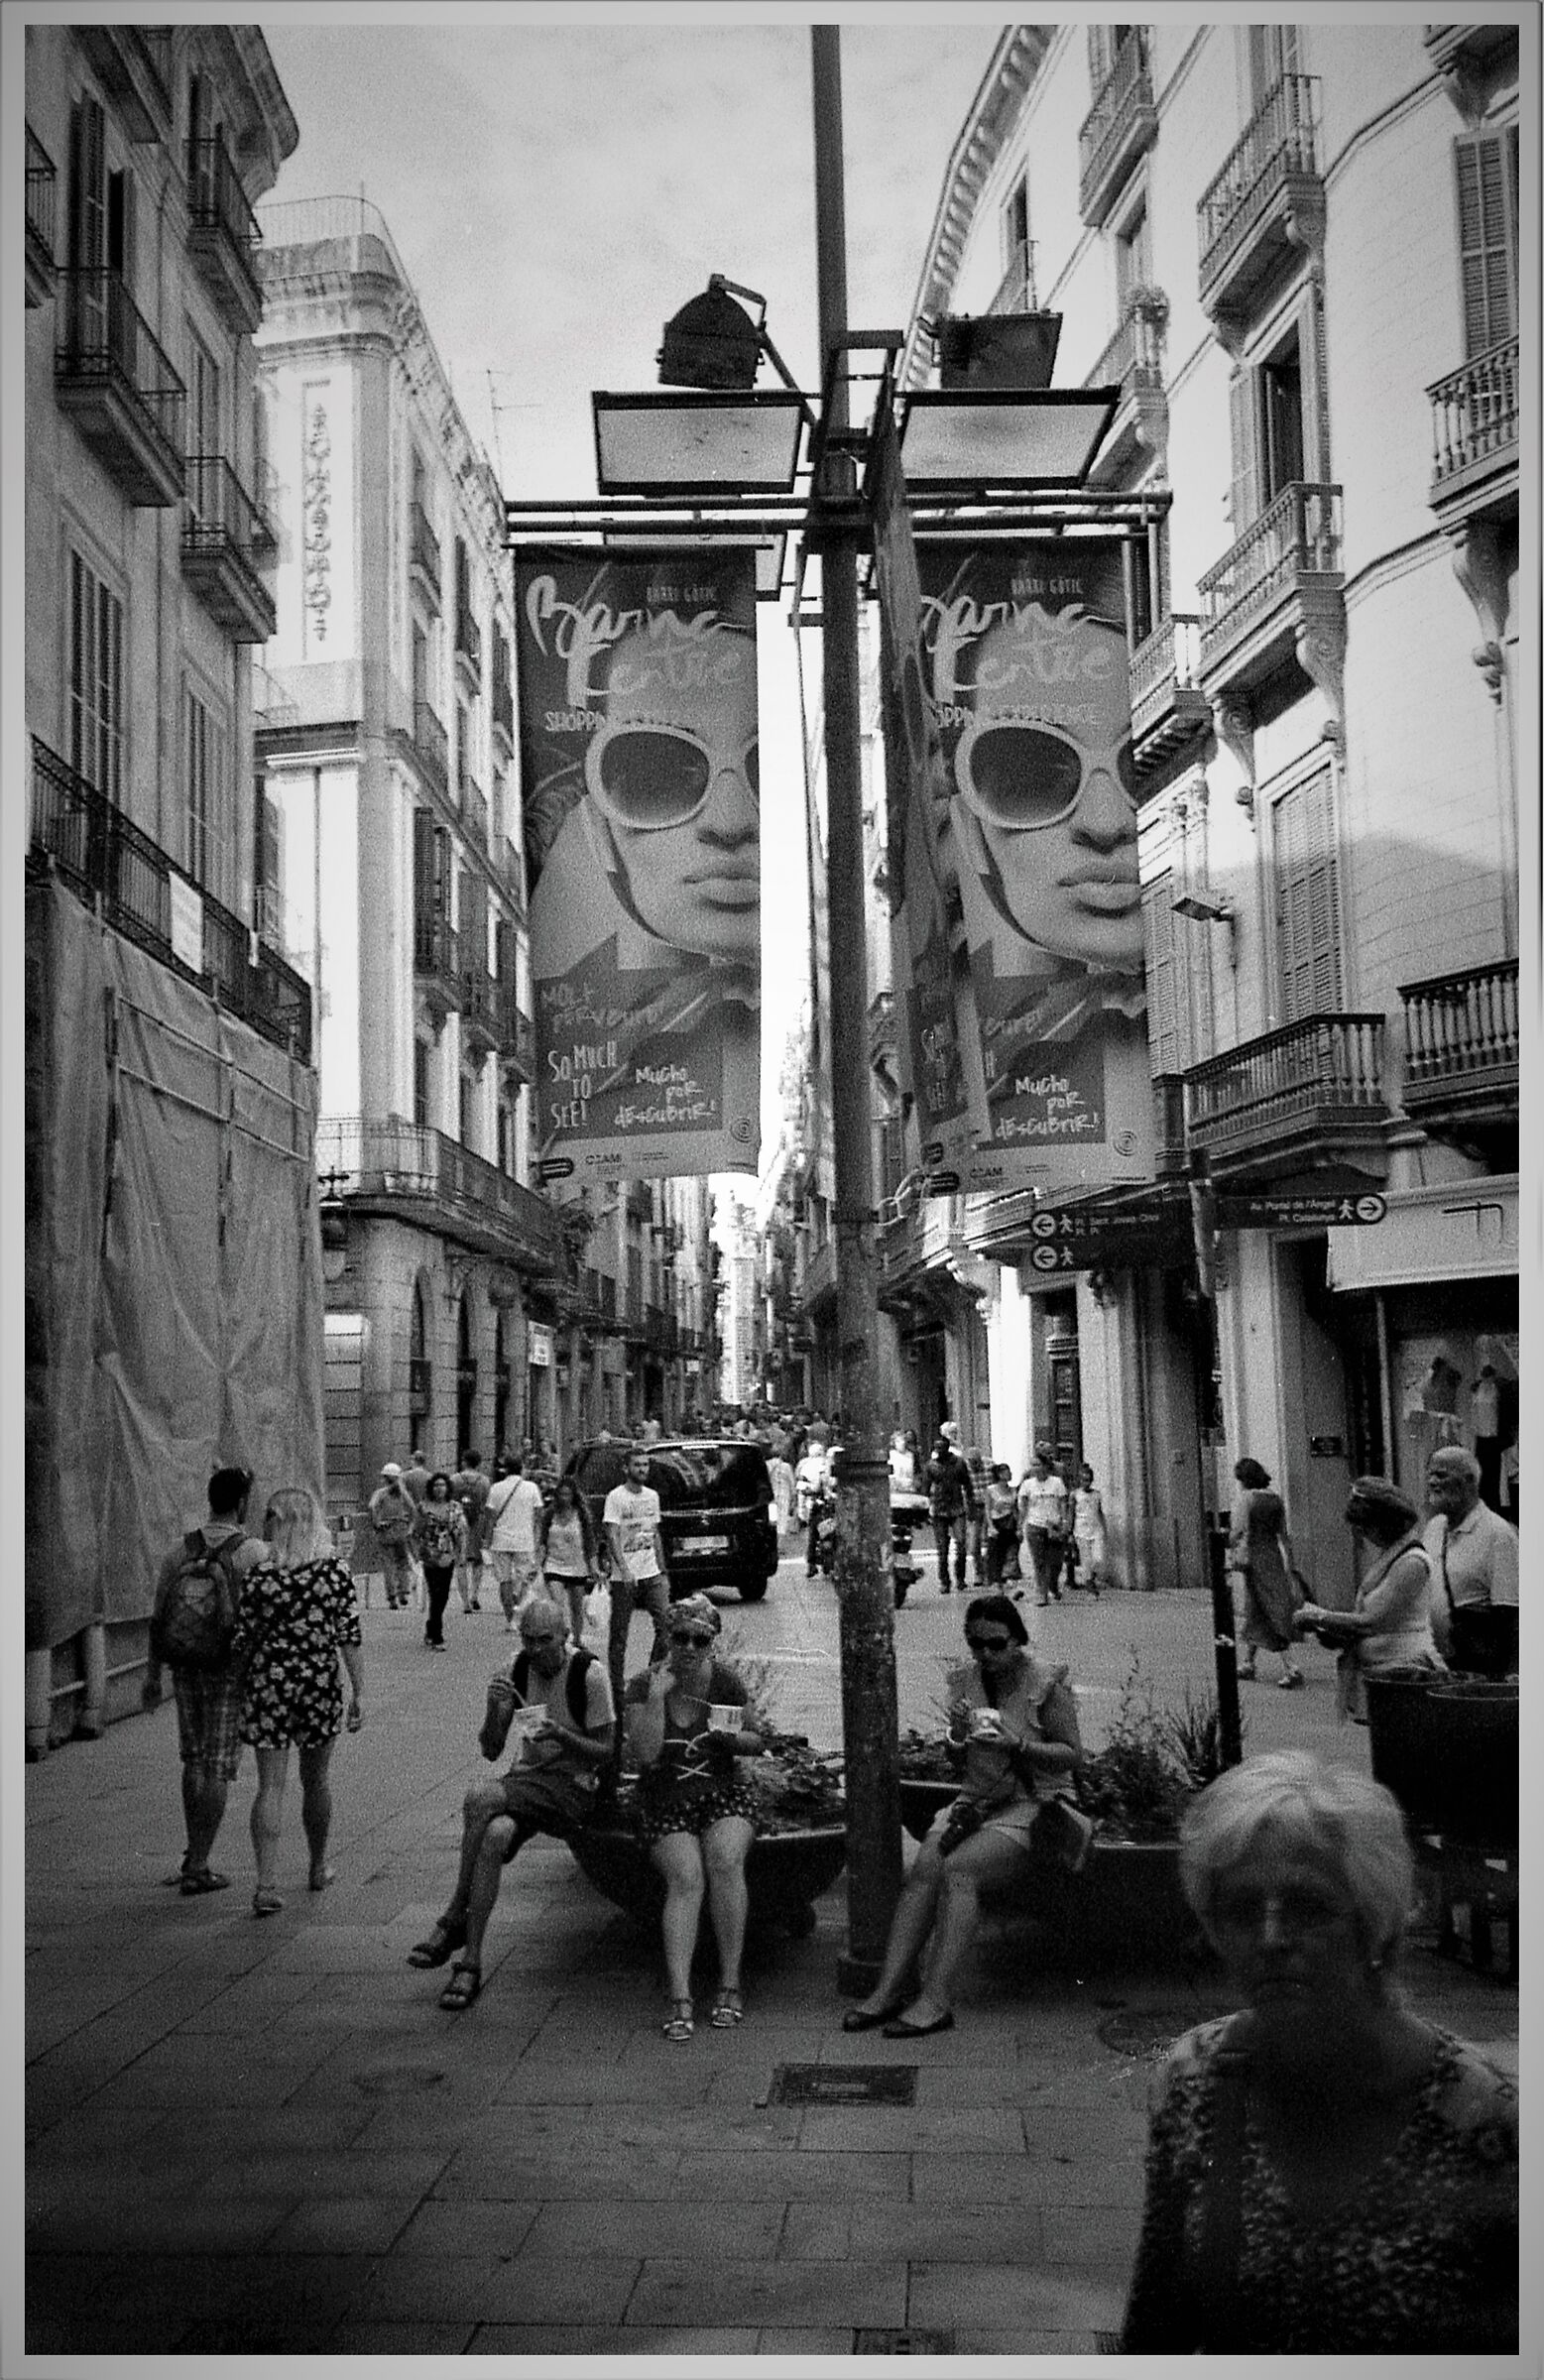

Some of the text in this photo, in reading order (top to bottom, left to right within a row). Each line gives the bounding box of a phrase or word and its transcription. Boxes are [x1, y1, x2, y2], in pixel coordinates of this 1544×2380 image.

[547, 1041, 618, 1083] SO MUCH
[572, 1074, 593, 1100] TO
[550, 1099, 587, 1130] SEE!
